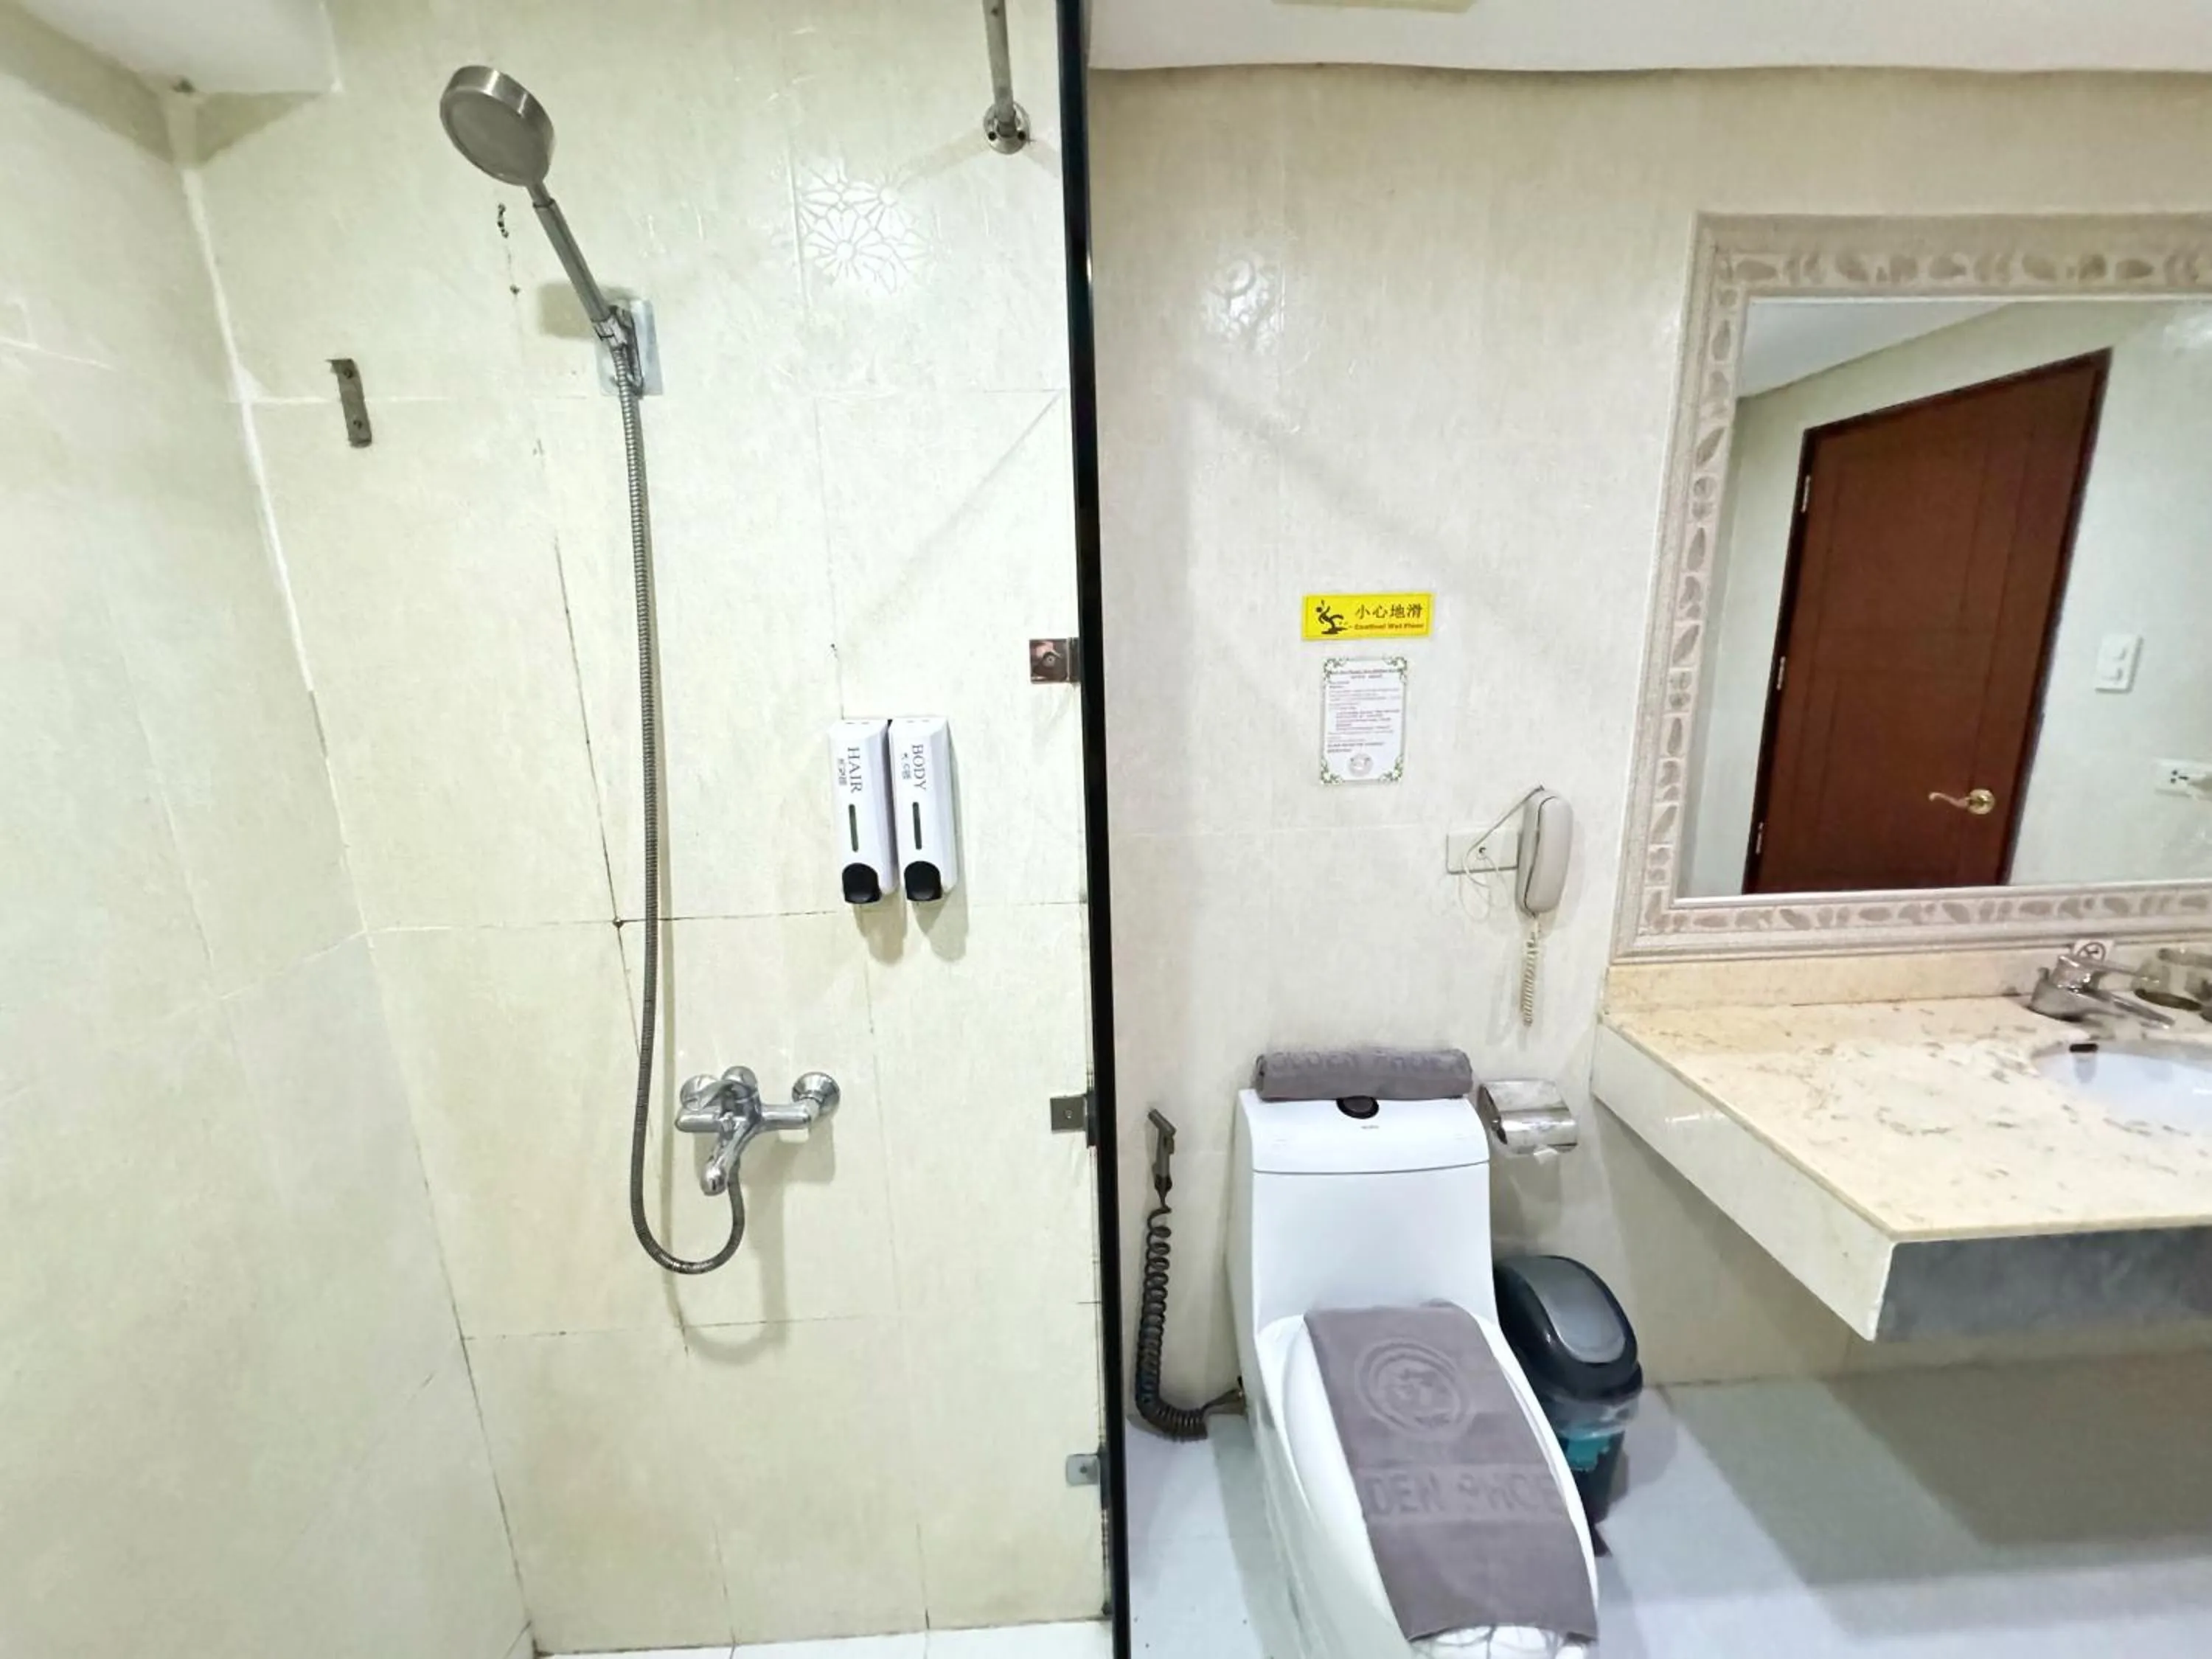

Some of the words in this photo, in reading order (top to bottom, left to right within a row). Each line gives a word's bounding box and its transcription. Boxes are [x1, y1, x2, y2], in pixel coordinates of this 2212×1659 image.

[1355, 604, 1422, 619] 小心地滑
[848, 747, 862, 793] HAIR
[911, 744, 927, 791] BODY
